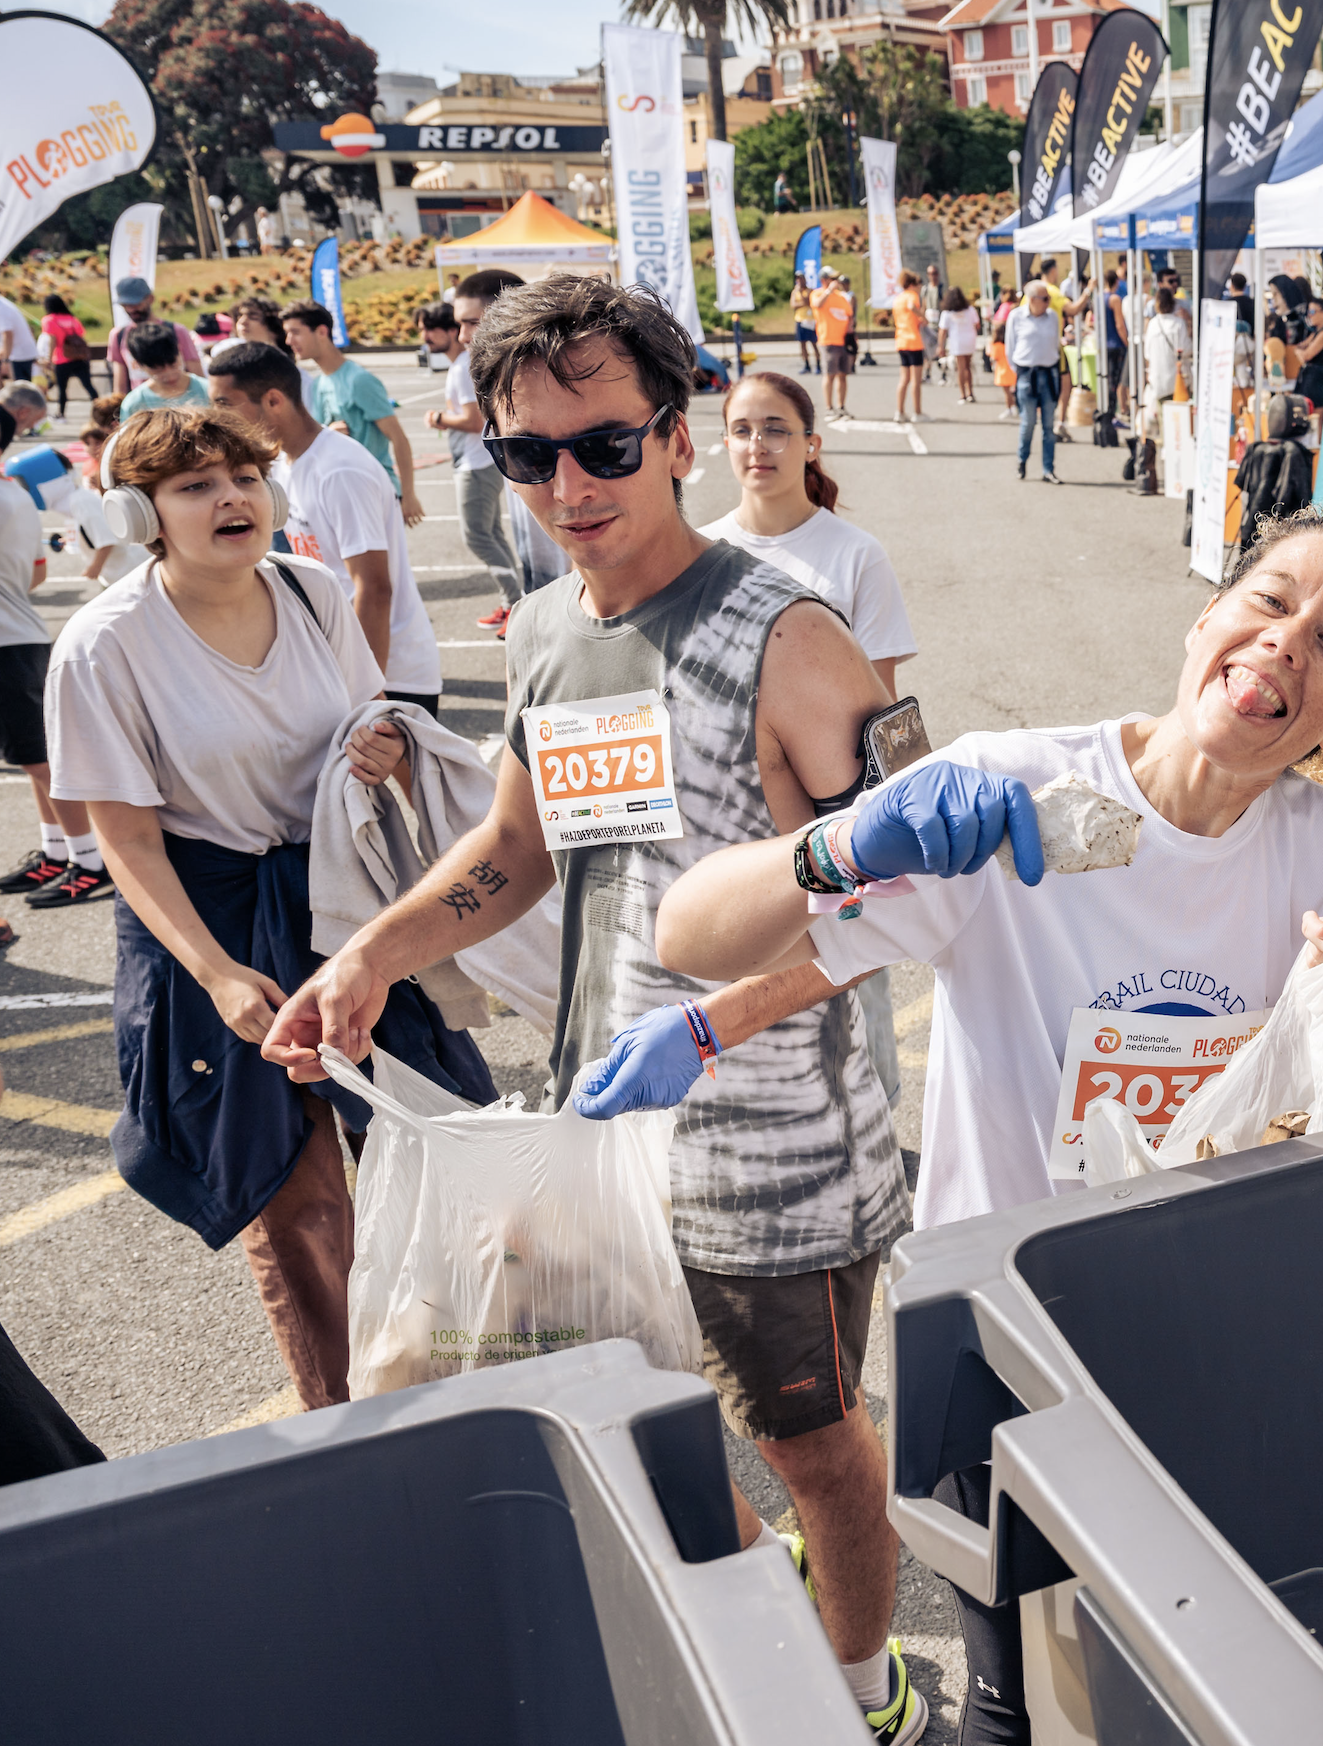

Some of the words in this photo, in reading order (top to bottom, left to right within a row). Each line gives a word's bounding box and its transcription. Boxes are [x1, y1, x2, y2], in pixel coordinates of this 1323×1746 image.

[1081, 41, 1152, 208] #BEACTIVE
[418, 126, 561, 149] REPSOL
[6, 114, 138, 200] PLOGGING
[1027, 87, 1077, 220] #BEACTIVE
[553, 719, 579, 728] nationale
[555, 726, 589, 736] nederlanden
[596, 711, 654, 735] PLOGGING
[544, 743, 656, 793] 20379
[560, 822, 666, 843] #HAZDEPORTEPORELPLANETA
[1160, 969, 1246, 1014] CIUDAD
[1125, 1043, 1182, 1054] nederlanden
[1126, 1034, 1169, 1044] nationale
[1090, 1071, 1223, 1117] 203
[430, 1329, 473, 1345] 100%
[478, 1326, 585, 1347] compostable
[430, 1349, 481, 1361] Producto
[485, 1349, 500, 1361] de
